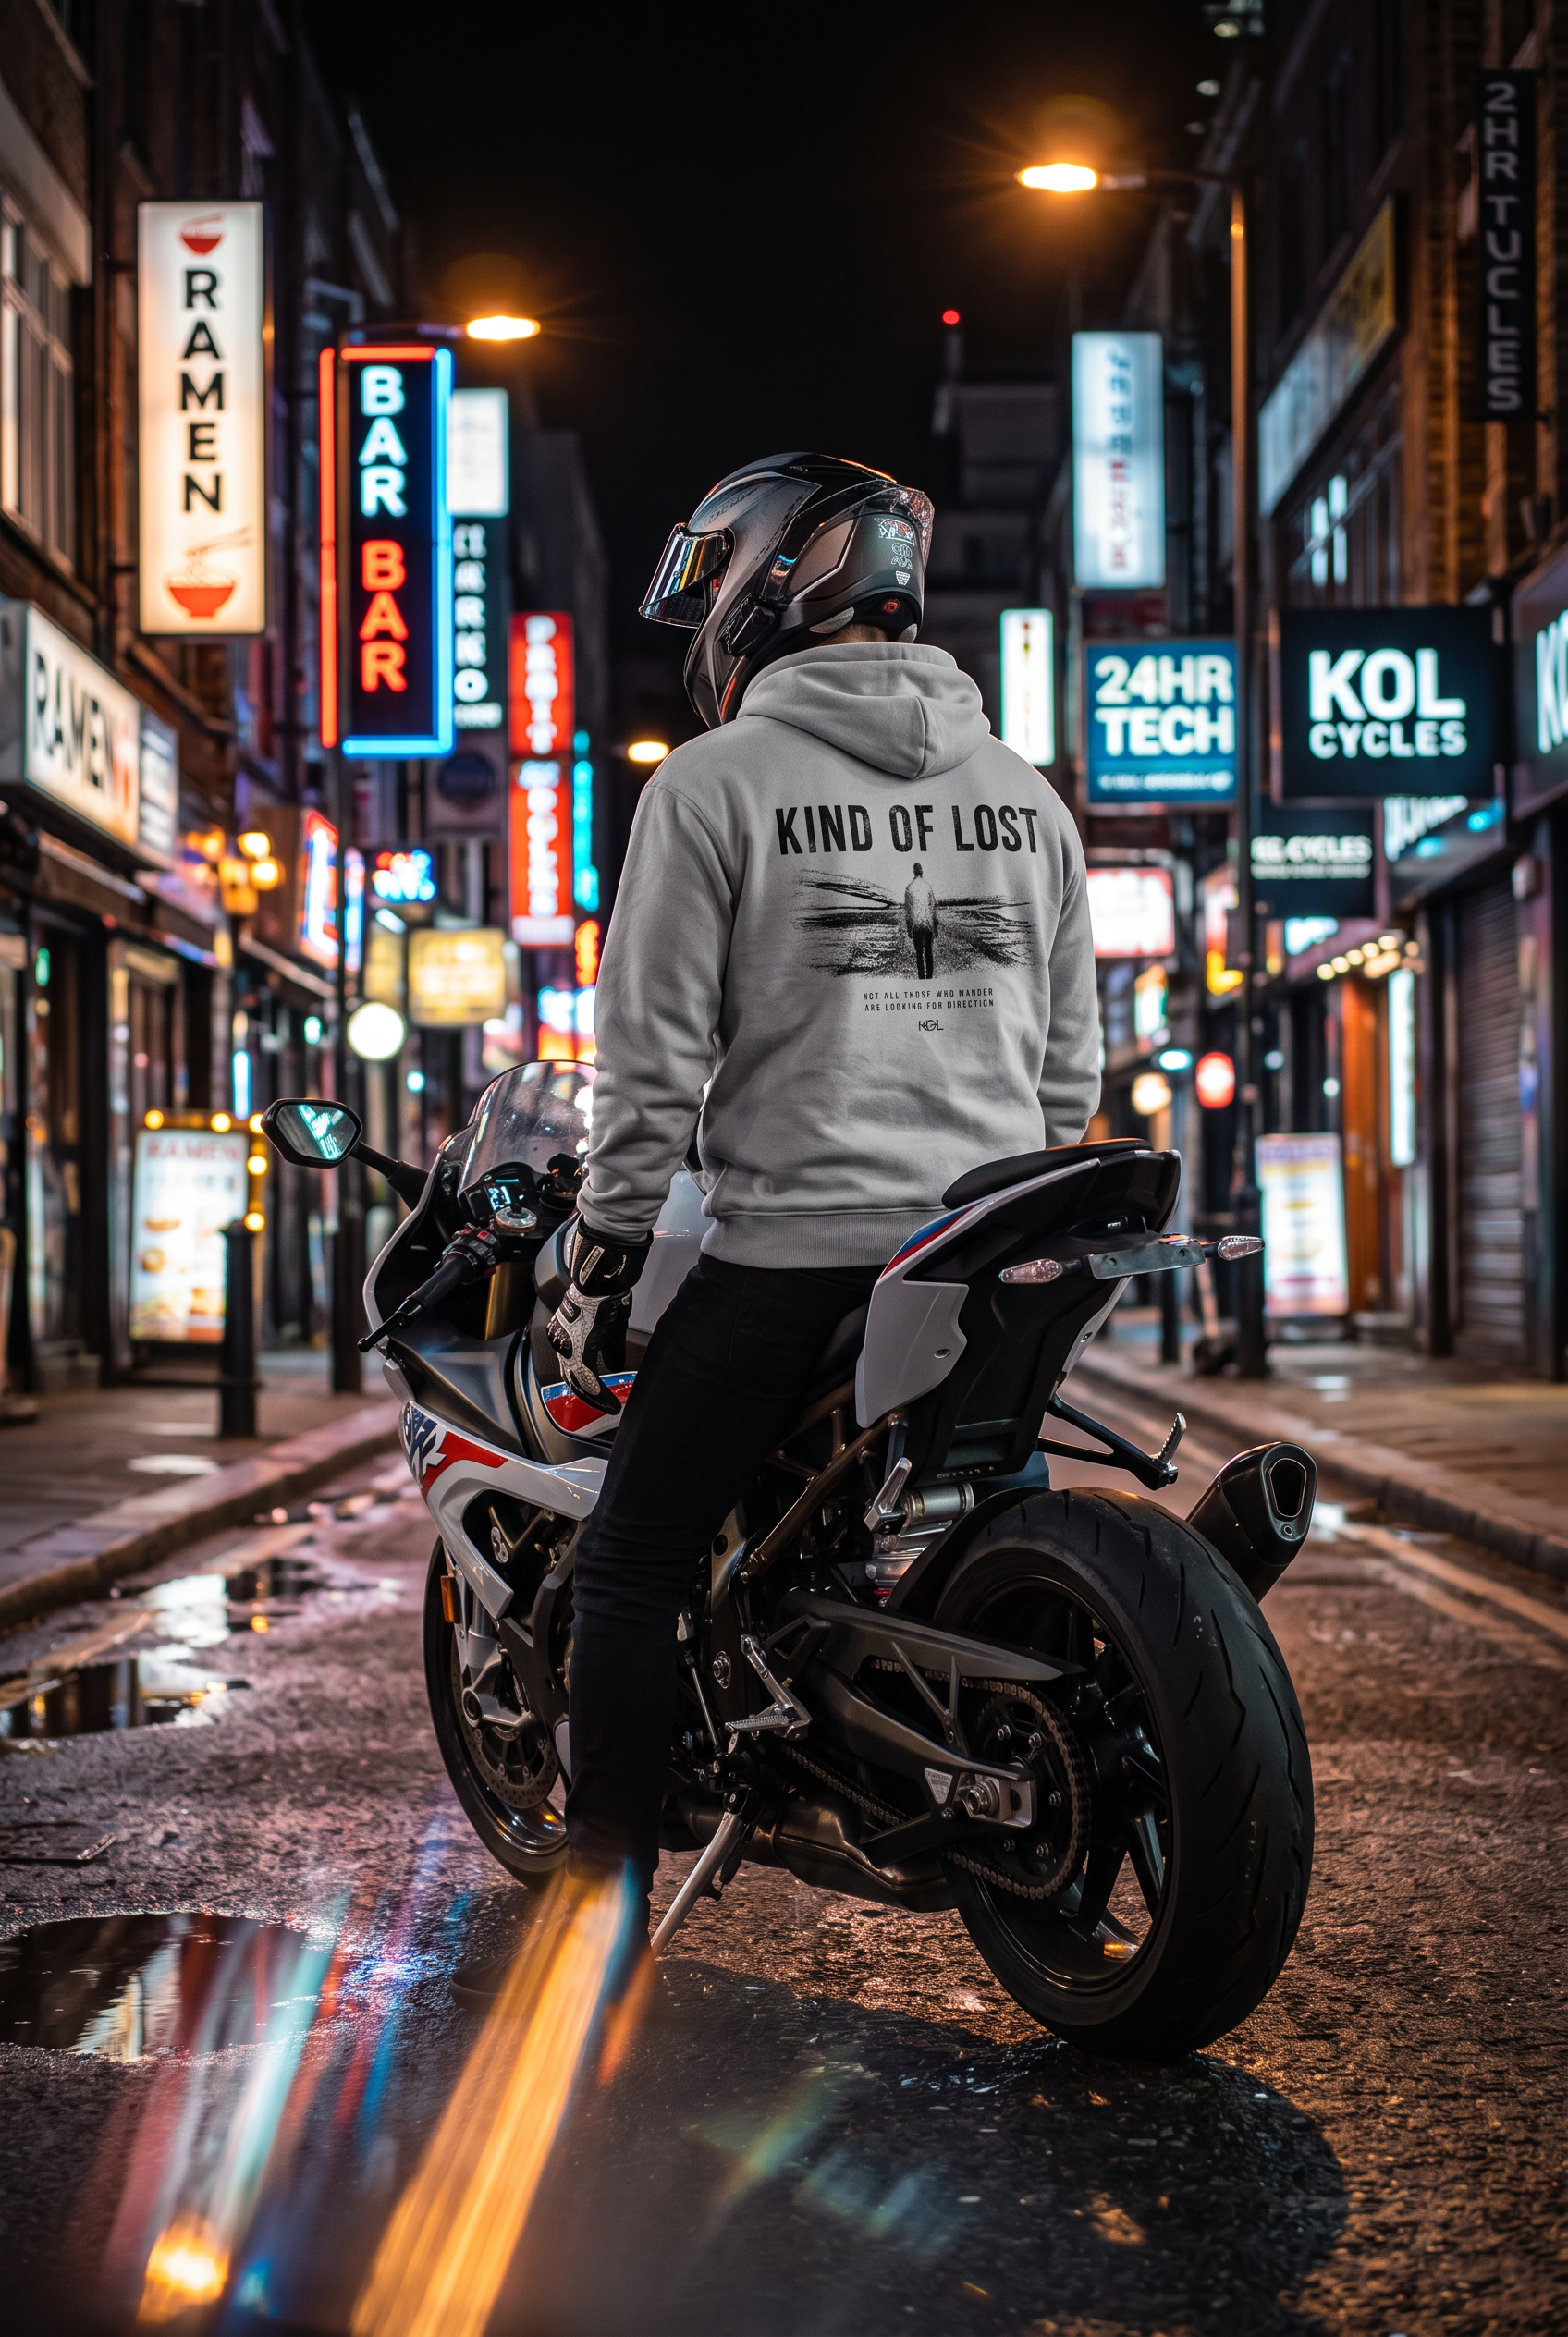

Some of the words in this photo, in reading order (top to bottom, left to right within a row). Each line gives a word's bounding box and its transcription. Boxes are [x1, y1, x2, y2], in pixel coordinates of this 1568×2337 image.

[1484, 81, 1519, 181] 2HR
[1485, 195, 1522, 410] TUCLES
[180, 269, 225, 513] RAMEN
[359, 366, 408, 516] BAR
[359, 540, 409, 692] BAR
[1094, 655, 1235, 704] 24HR
[1309, 648, 1467, 722] KOL
[1094, 705, 1235, 756] TECH
[1309, 720, 1468, 759] CYCLES
[776, 804, 873, 855] KIND
[888, 804, 934, 852] OF
[951, 804, 1038, 853] LOST
[864, 1003, 881, 1012] ARE
[885, 1002, 923, 1011] LOOKING
[926, 1001, 943, 1009] FOR
[947, 998, 995, 1009] DIRECTION
[884, 991, 900, 999] ALL
[936, 989, 954, 998] WHO
